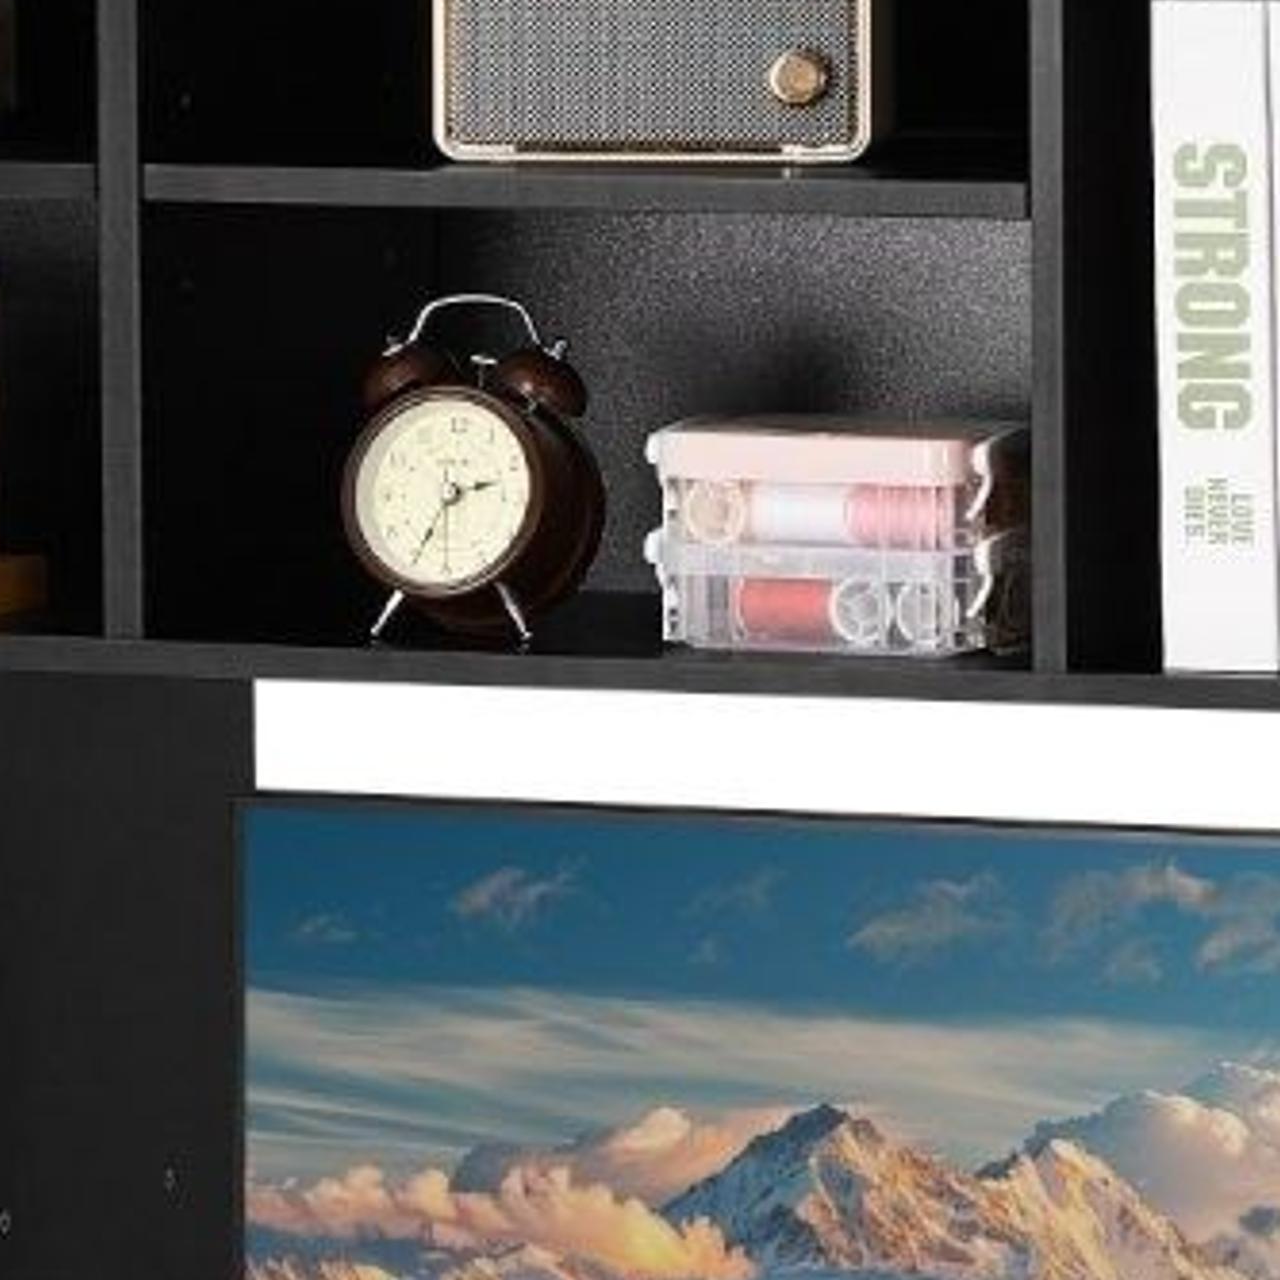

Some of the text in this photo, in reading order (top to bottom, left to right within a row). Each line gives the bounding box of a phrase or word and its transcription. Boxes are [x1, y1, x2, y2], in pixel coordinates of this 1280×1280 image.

[1173, 142, 1253, 431] STRONG
[1207, 477, 1229, 545] NEVER
[1230, 493, 1255, 550] LOVE
